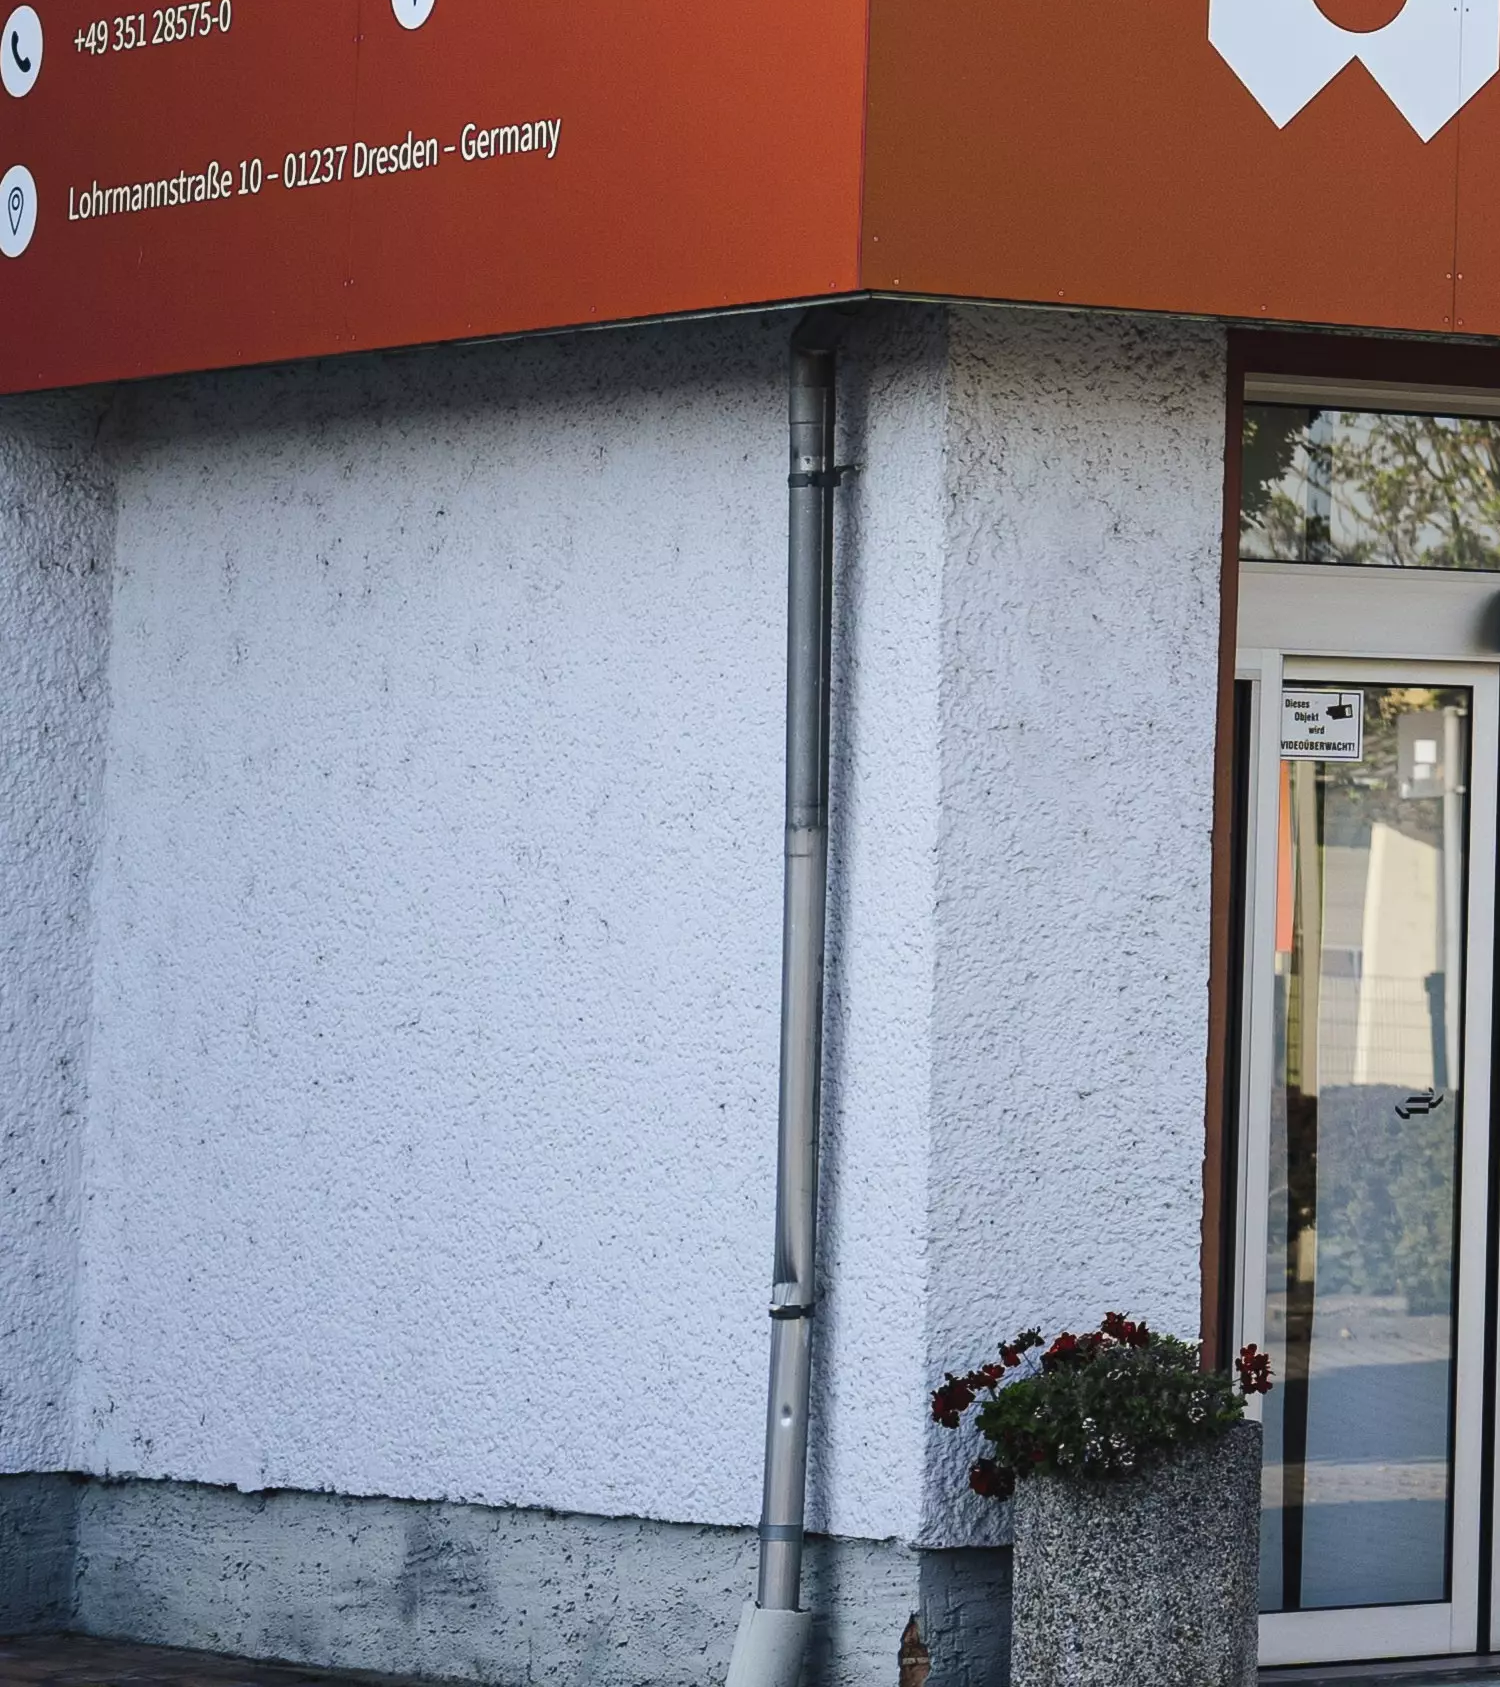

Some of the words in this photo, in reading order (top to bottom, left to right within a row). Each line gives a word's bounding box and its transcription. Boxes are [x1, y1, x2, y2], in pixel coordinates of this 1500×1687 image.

[74, 20, 109, 55] +49
[112, 13, 146, 51] 351
[68, 161, 233, 221] Lohrmannstraße
[238, 158, 263, 196] 10
[283, 146, 348, 190] 01237
[353, 130, 439, 178] Dresden
[461, 118, 562, 162] Germany
[1285, 698, 1310, 708] Dieses
[1294, 712, 1319, 723] Objekt
[1308, 725, 1325, 734] wird
